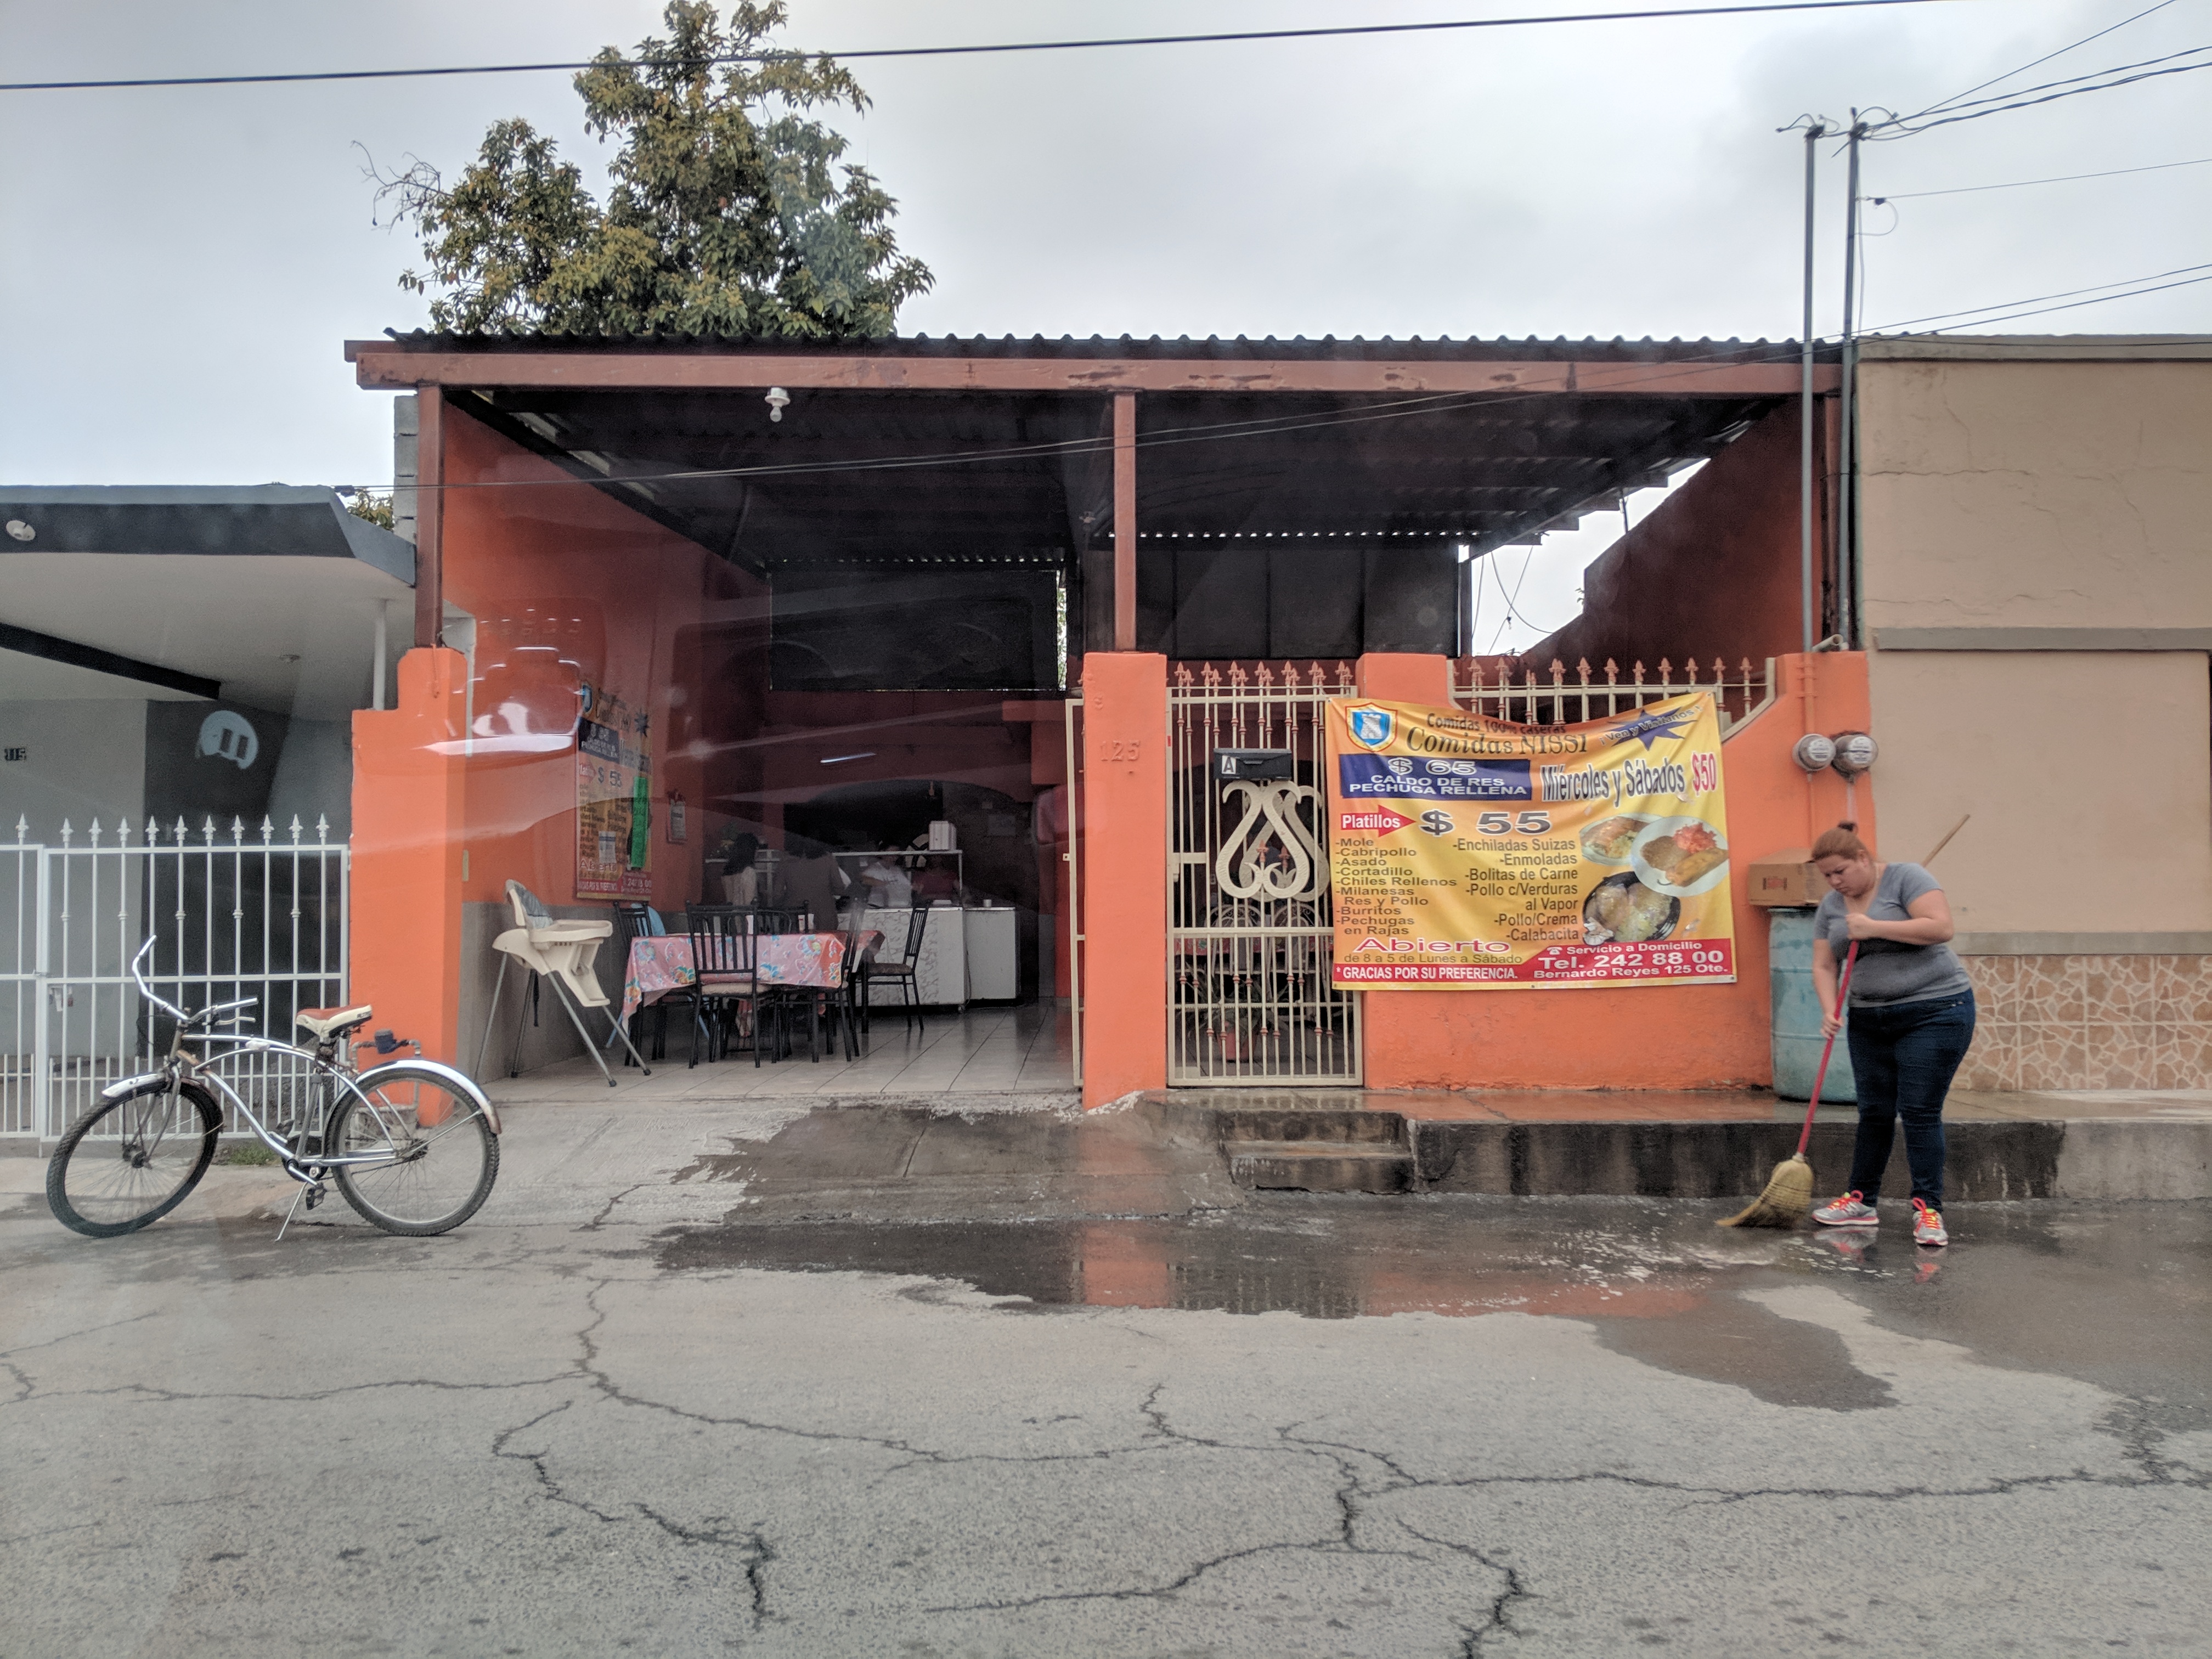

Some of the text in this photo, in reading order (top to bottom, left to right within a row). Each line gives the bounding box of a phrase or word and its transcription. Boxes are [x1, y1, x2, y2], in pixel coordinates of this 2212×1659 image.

[1427, 712, 1480, 732] Comidas
[1630, 726, 1639, 737] y
[1639, 708, 1695, 731] Visitanos
[1407, 726, 1587, 755] Comidas NISSI
[1100, 741, 1140, 761] 125
[1223, 757, 1235, 773] A
[1387, 757, 1477, 775] $ 65
[1371, 775, 1504, 786] CALDO DE RES
[1540, 752, 1717, 808] Miércoles y Sábados $50
[1350, 784, 1527, 795] PECHUGA RELLENA
[1341, 815, 1401, 828] Platillos
[1418, 809, 1552, 837] $ 55
[1532, 838, 1576, 851] Suizas
[1520, 868, 1536, 879] de
[1539, 867, 1578, 879] Carne
[1391, 877, 1457, 886] Rellenos
[1509, 882, 1578, 896] c/Verduras
[1345, 896, 1429, 908] Res y Pollo
[1526, 898, 1578, 912] al Vapor
[1367, 926, 1409, 936] Rajas
[1353, 937, 1510, 953] Abierto
[1566, 945, 1622, 955] Servicio
[1638, 941, 1702, 952] Domicilio
[1344, 953, 1359, 962] de
[1363, 954, 1371, 962] 8
[1387, 954, 1395, 963] 5
[1399, 954, 1414, 963] de
[1419, 954, 1455, 963] Lunes
[1472, 953, 1522, 963] Sábado
[1538, 951, 1724, 969] Tel. 242 88 00
[1343, 967, 1519, 979] GRACIAS POR SU PREFERENCIA.
[1534, 964, 1728, 979] Bernardo Reyes 125 Ote.
